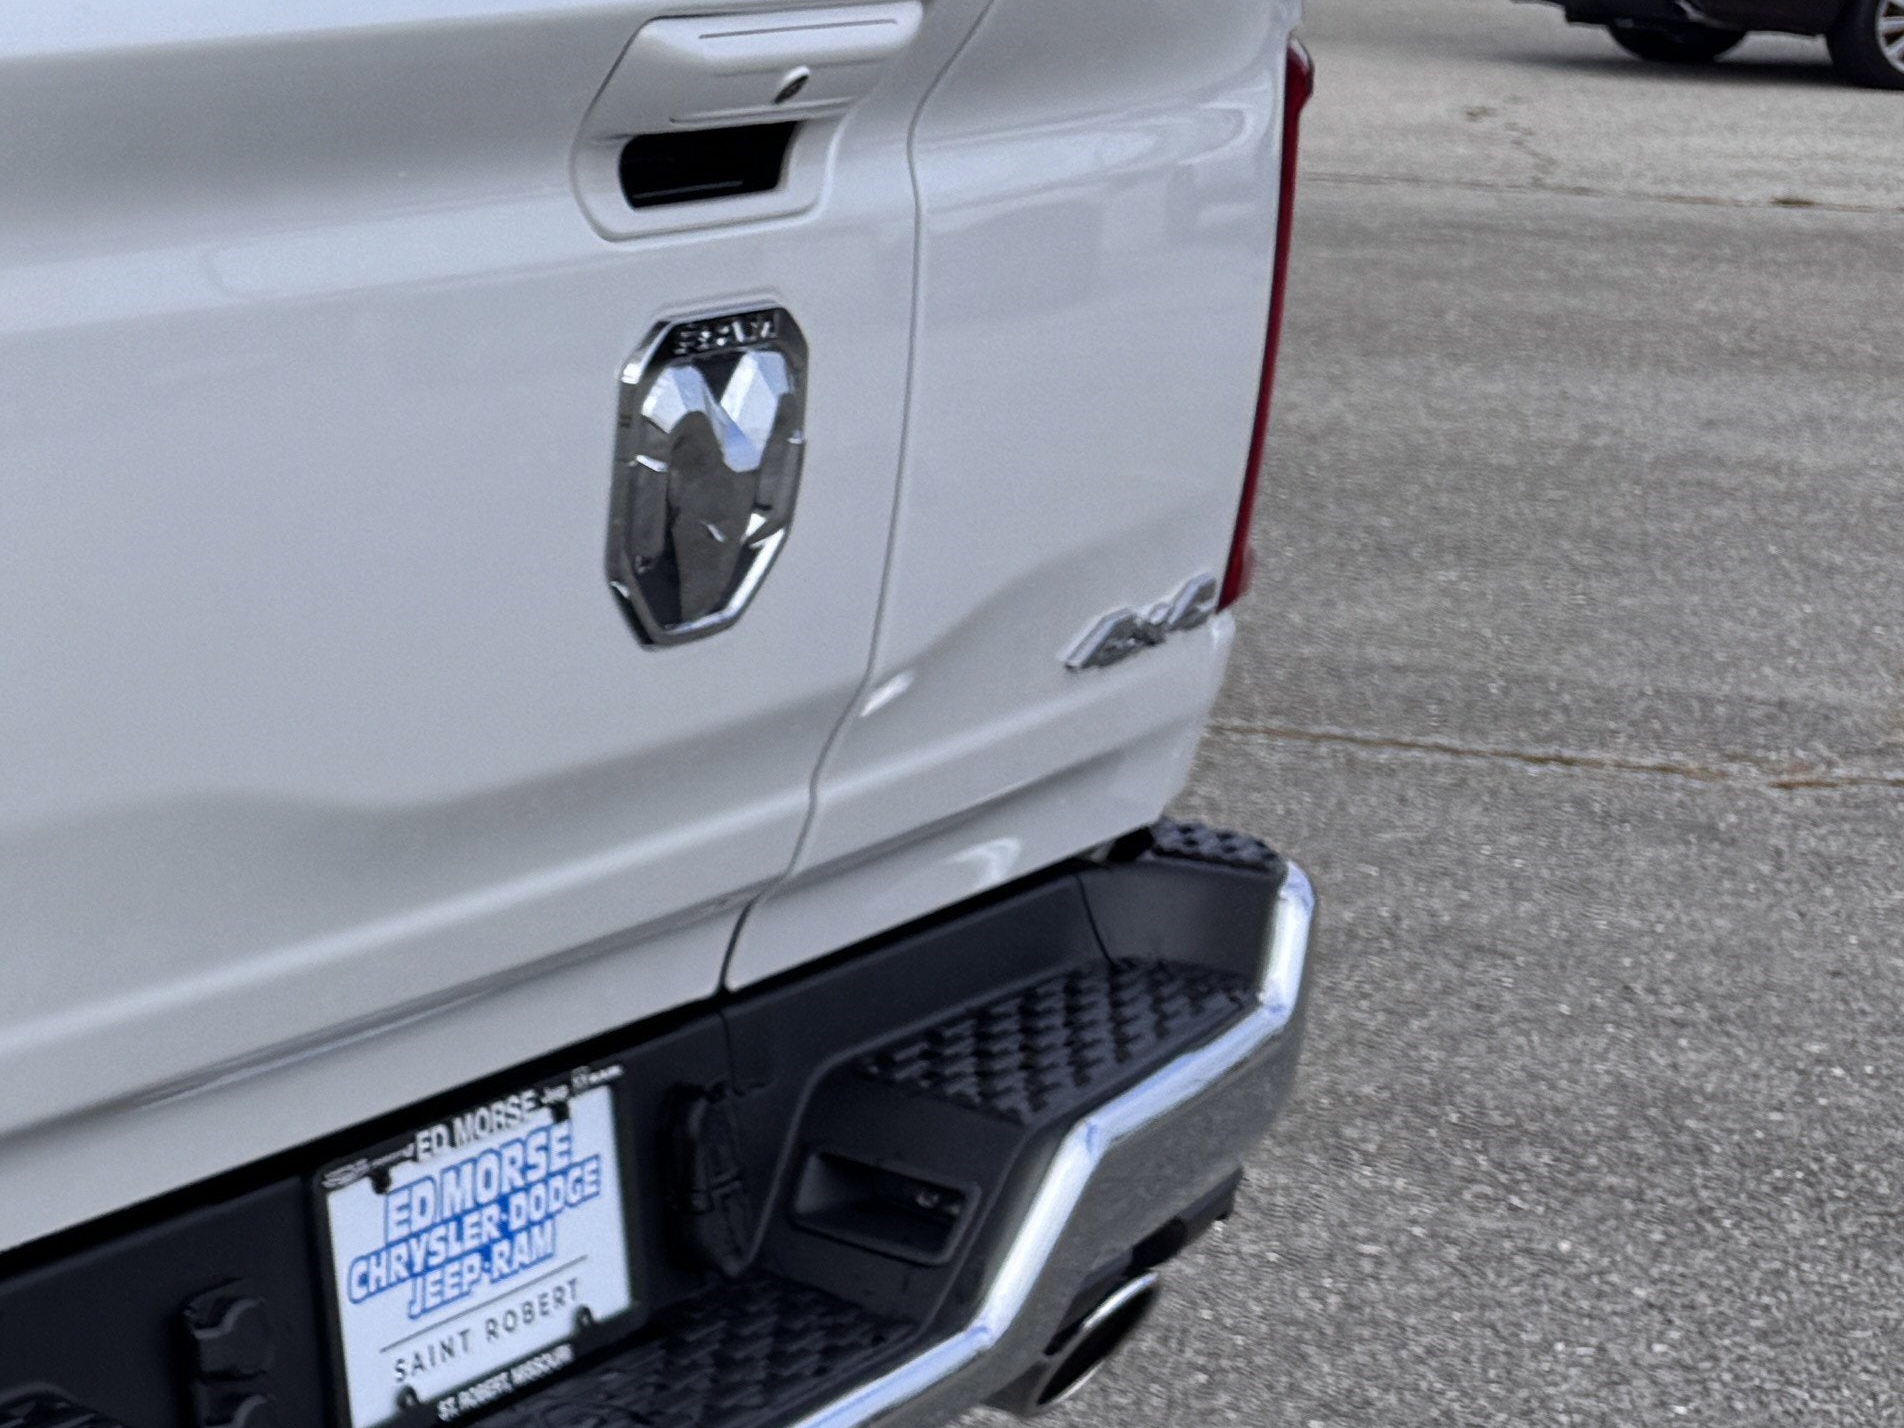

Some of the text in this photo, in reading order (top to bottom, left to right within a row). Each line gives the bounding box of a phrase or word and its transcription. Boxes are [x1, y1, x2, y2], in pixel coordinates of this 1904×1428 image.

[415, 1124, 449, 1162] ED
[452, 1089, 540, 1149] MORSE
[385, 1122, 573, 1245] ED MORSE
[394, 1277, 578, 1382] SAINT ROBERT
